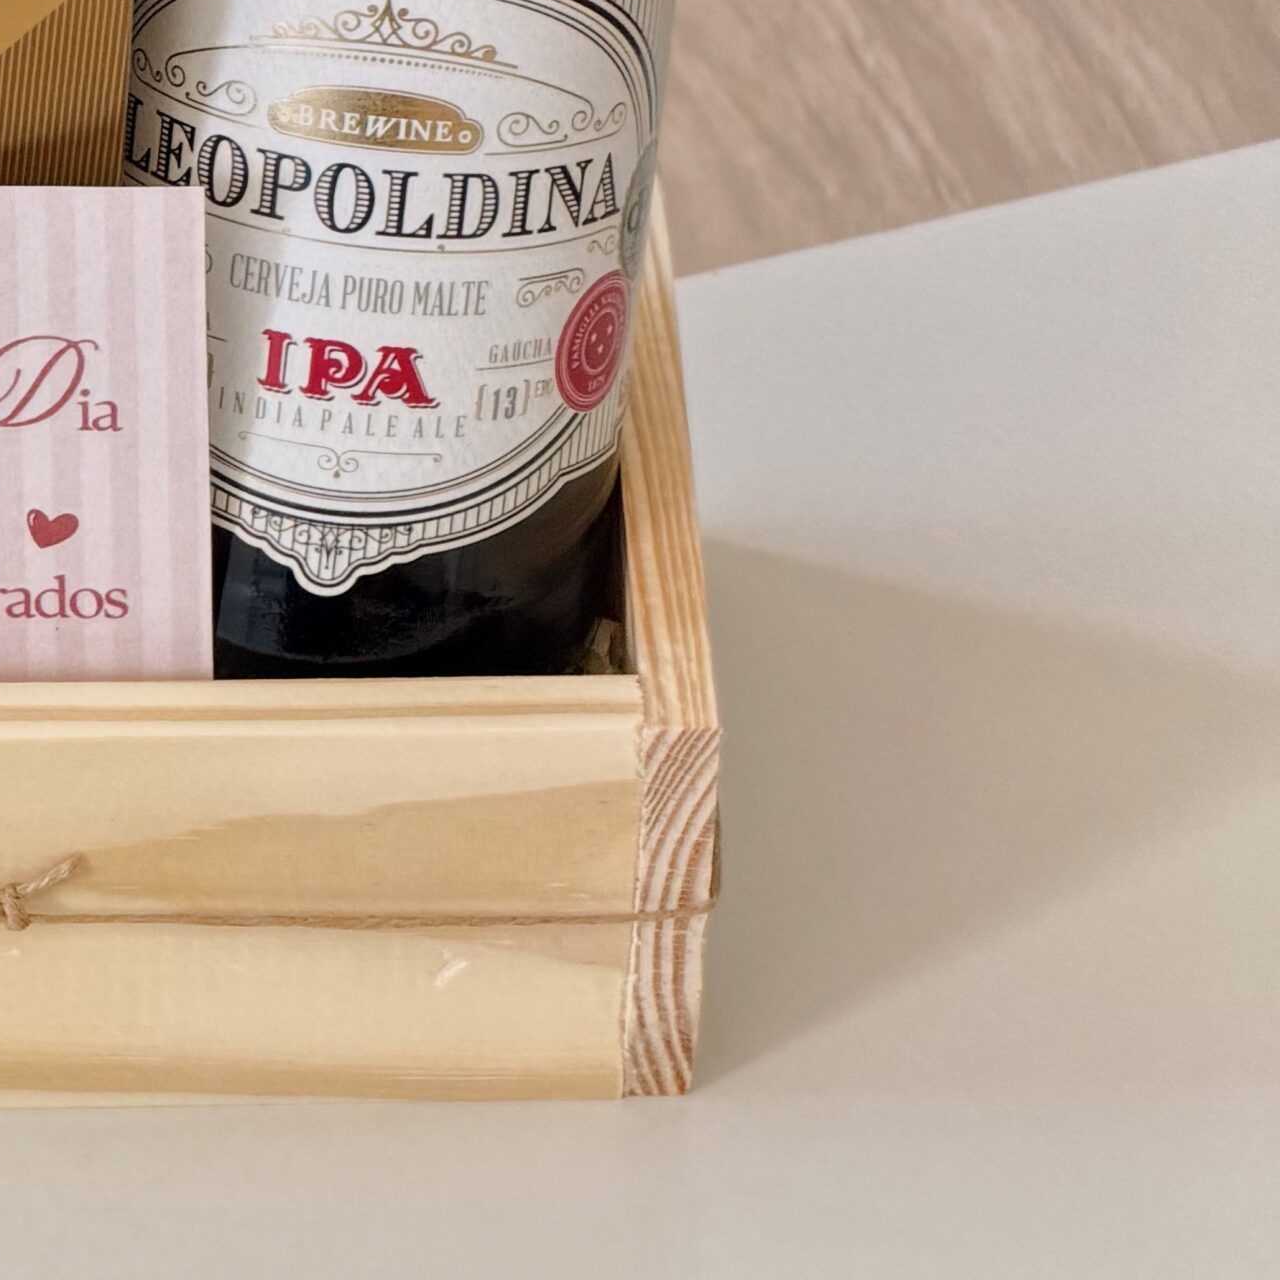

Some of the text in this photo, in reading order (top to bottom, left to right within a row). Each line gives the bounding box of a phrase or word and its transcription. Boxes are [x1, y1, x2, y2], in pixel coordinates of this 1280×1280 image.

[297, 104, 454, 144] BREWINE
[124, 92, 620, 241] LEOPOLDINA
[229, 252, 489, 317] CERVEJA PURO MALTE
[256, 328, 441, 410] IPA
[218, 386, 467, 438] INDIA PALE ALE
